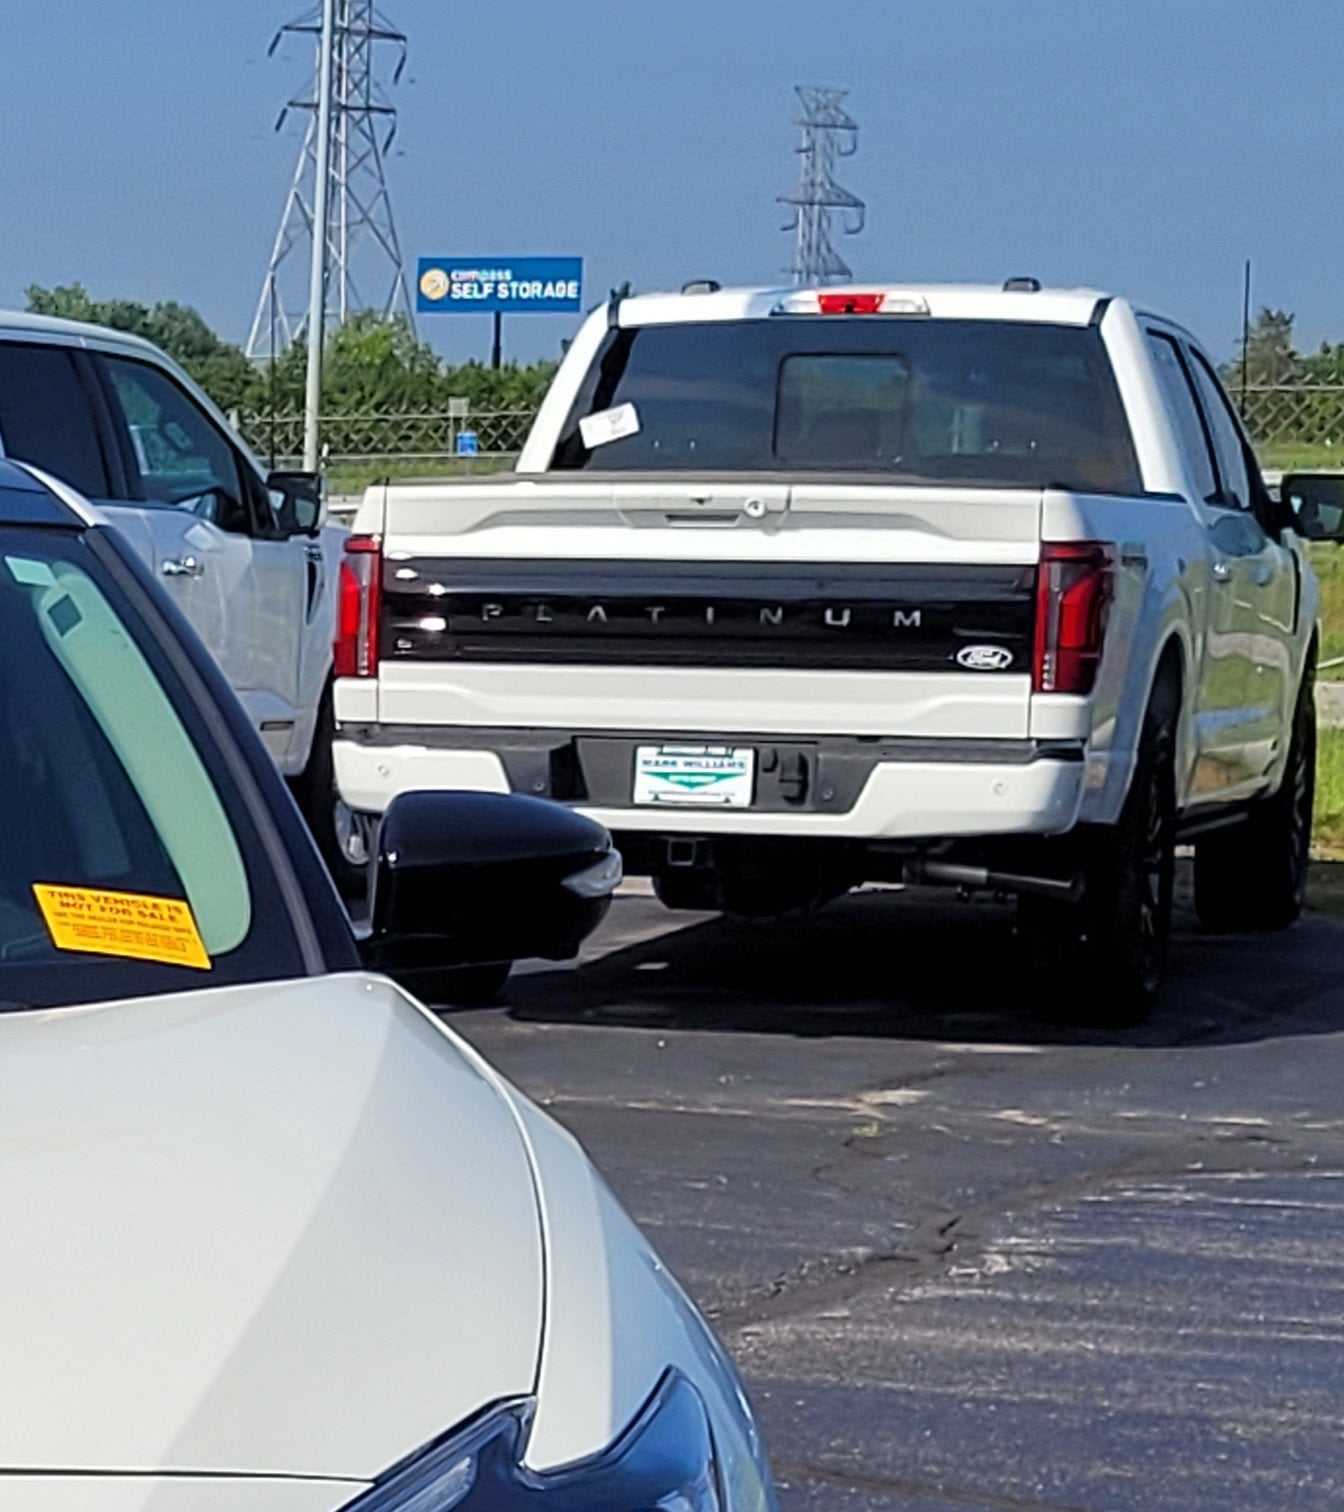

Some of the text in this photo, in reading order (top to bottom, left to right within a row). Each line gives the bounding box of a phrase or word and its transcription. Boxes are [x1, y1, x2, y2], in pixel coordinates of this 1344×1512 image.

[450, 280, 579, 300] SELF STORAGE
[480, 602, 922, 628] PLATINUM
